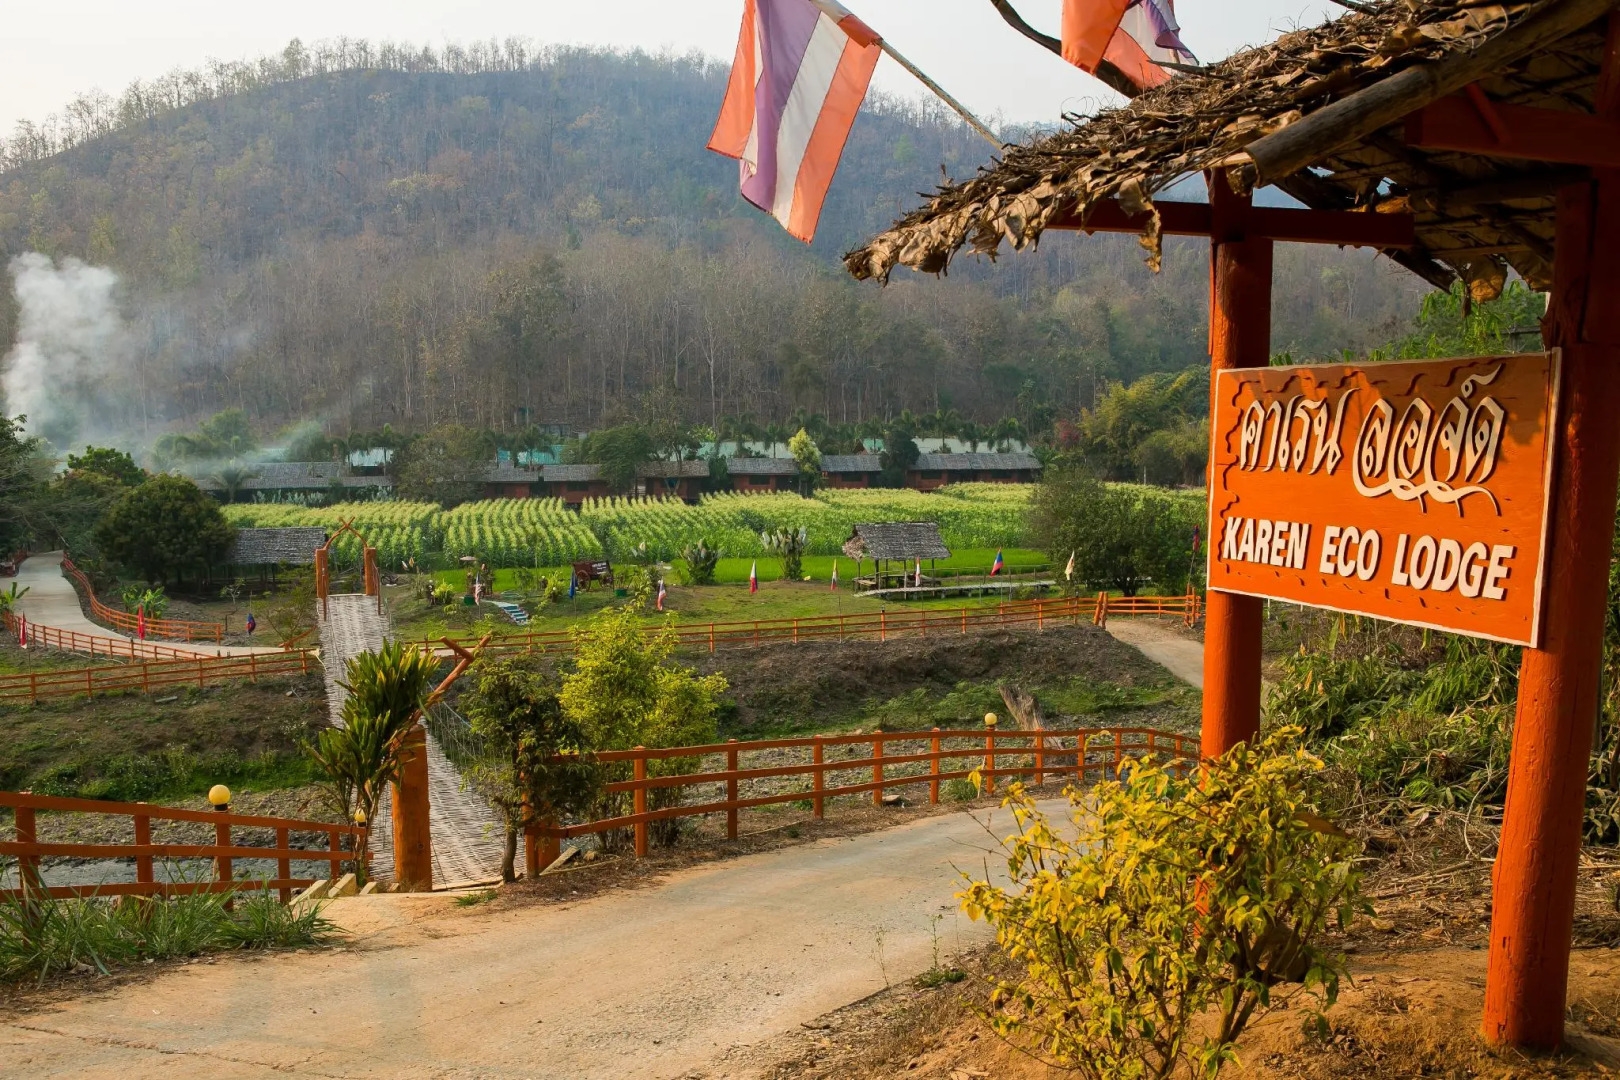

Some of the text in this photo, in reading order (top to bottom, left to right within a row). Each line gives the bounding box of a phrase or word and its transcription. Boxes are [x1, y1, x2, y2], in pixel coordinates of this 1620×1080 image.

[1239, 387, 1360, 475] คาเรน
[1223, 516, 1516, 600] KAREN ECO LODGE
